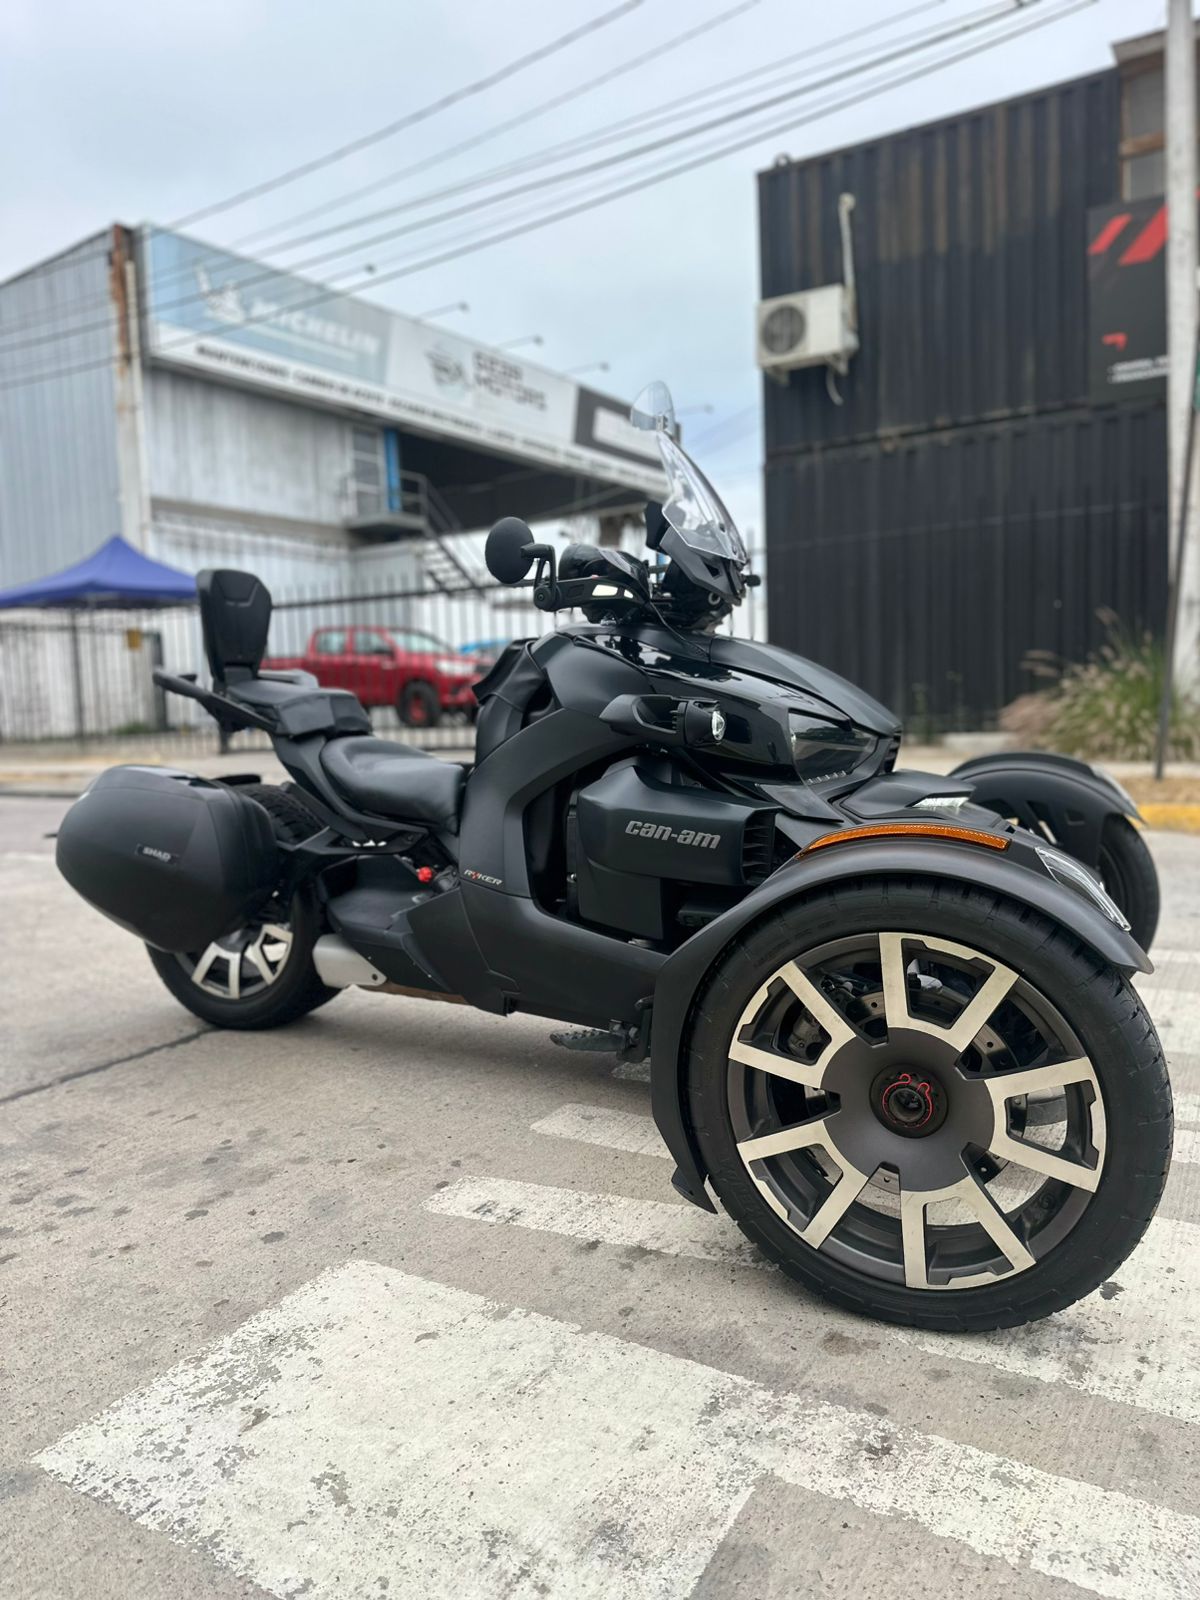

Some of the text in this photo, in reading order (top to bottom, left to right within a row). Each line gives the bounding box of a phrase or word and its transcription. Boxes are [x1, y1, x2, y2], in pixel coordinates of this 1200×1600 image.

[625, 820, 721, 849] can-am
[143, 846, 171, 862] SHAD
[464, 869, 503, 885] RYKER
